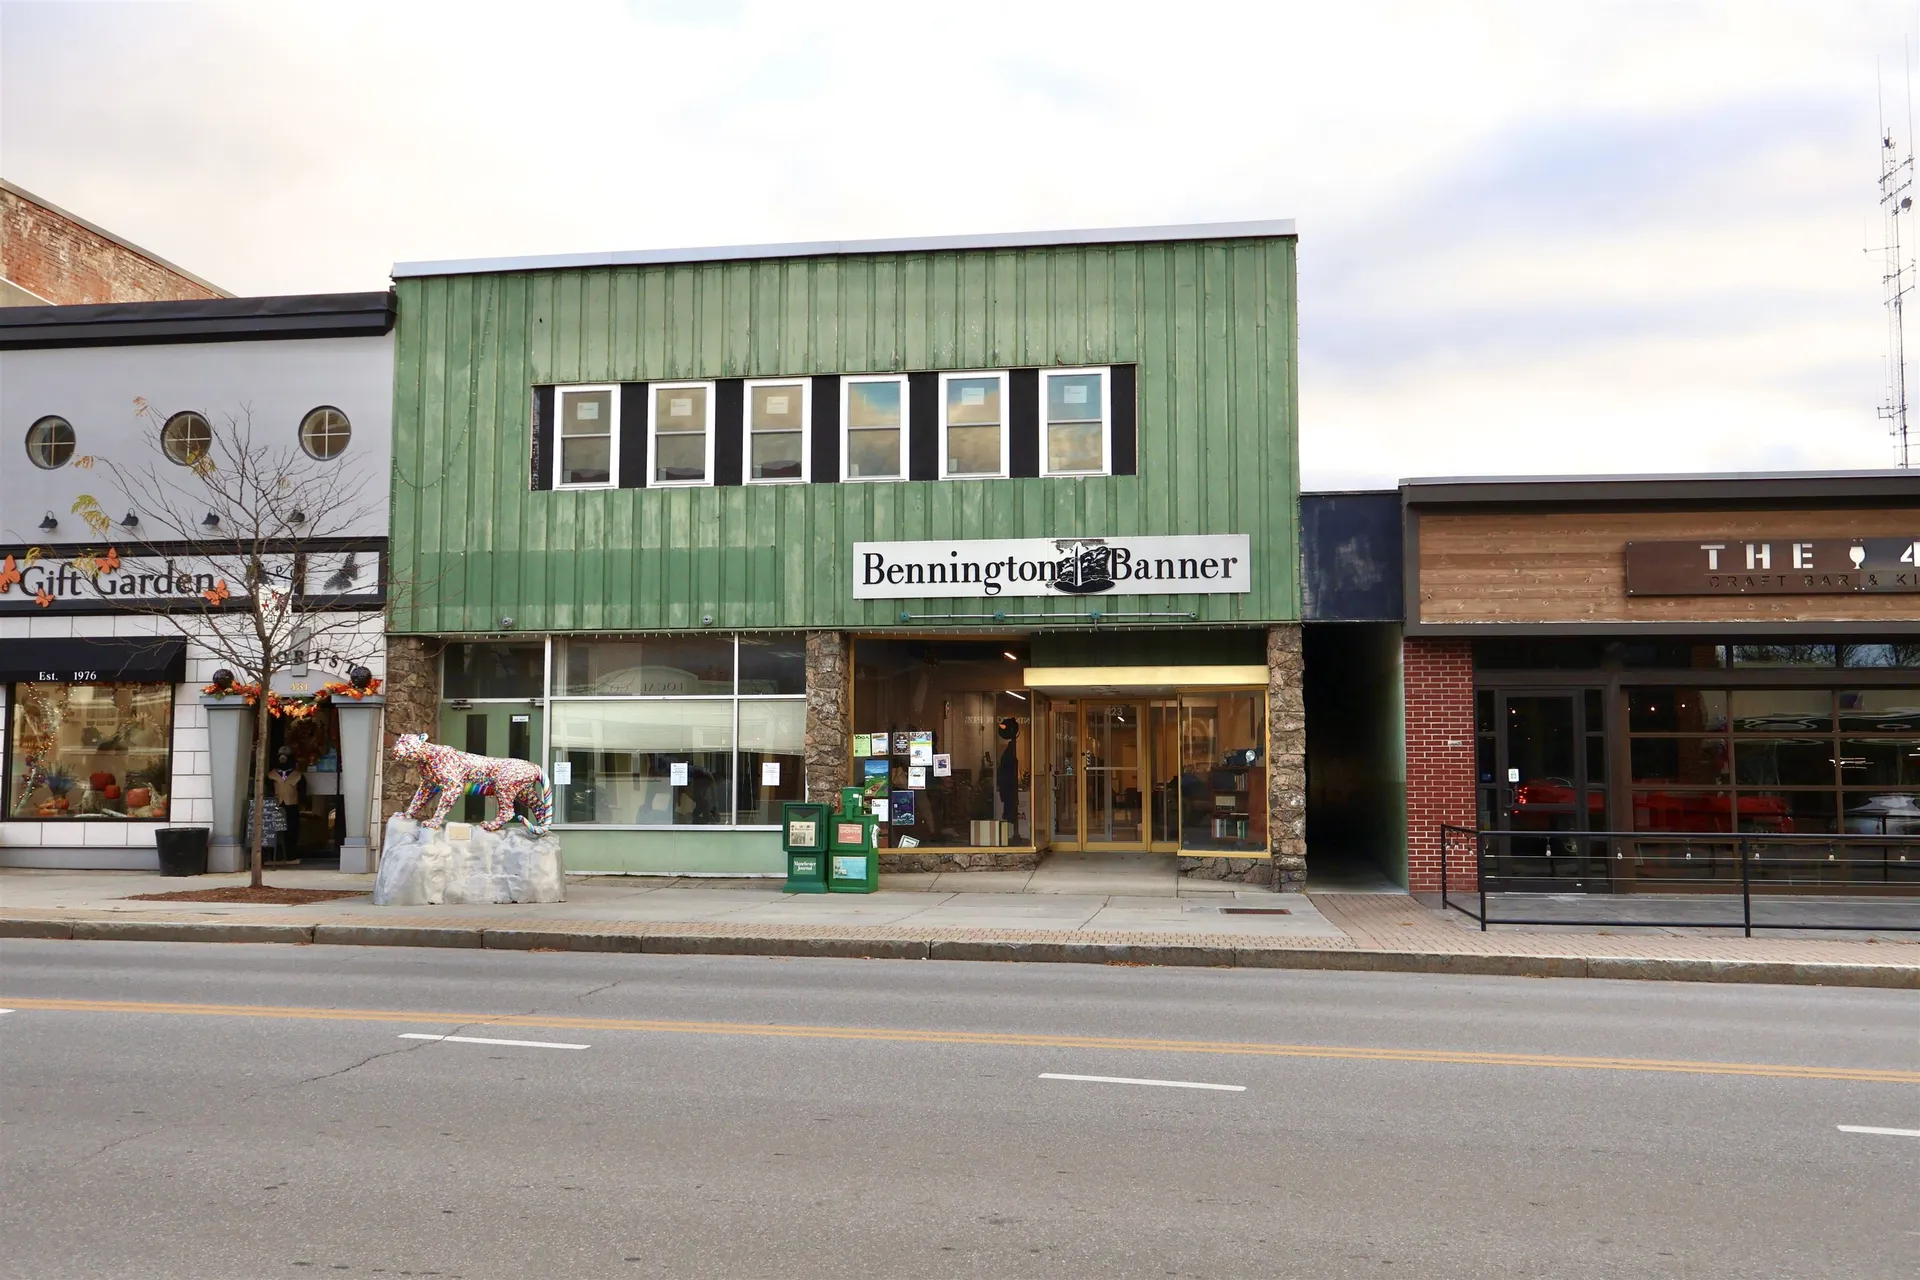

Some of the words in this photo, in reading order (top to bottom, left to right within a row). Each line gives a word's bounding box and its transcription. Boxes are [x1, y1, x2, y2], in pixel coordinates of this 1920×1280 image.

[1701, 543, 1813, 569] THE
[20, 562, 82, 597] Gift
[92, 559, 216, 597] Garden
[862, 551, 1059, 595] Bennington
[1110, 547, 1238, 580] Banner
[1709, 574, 1786, 589] CRAFT
[1804, 574, 1849, 588] BAR
[1868, 574, 1879, 587] &
[39, 671, 58, 680] Est.
[74, 671, 97, 680] 1976
[1104, 707, 1123, 716] 423
